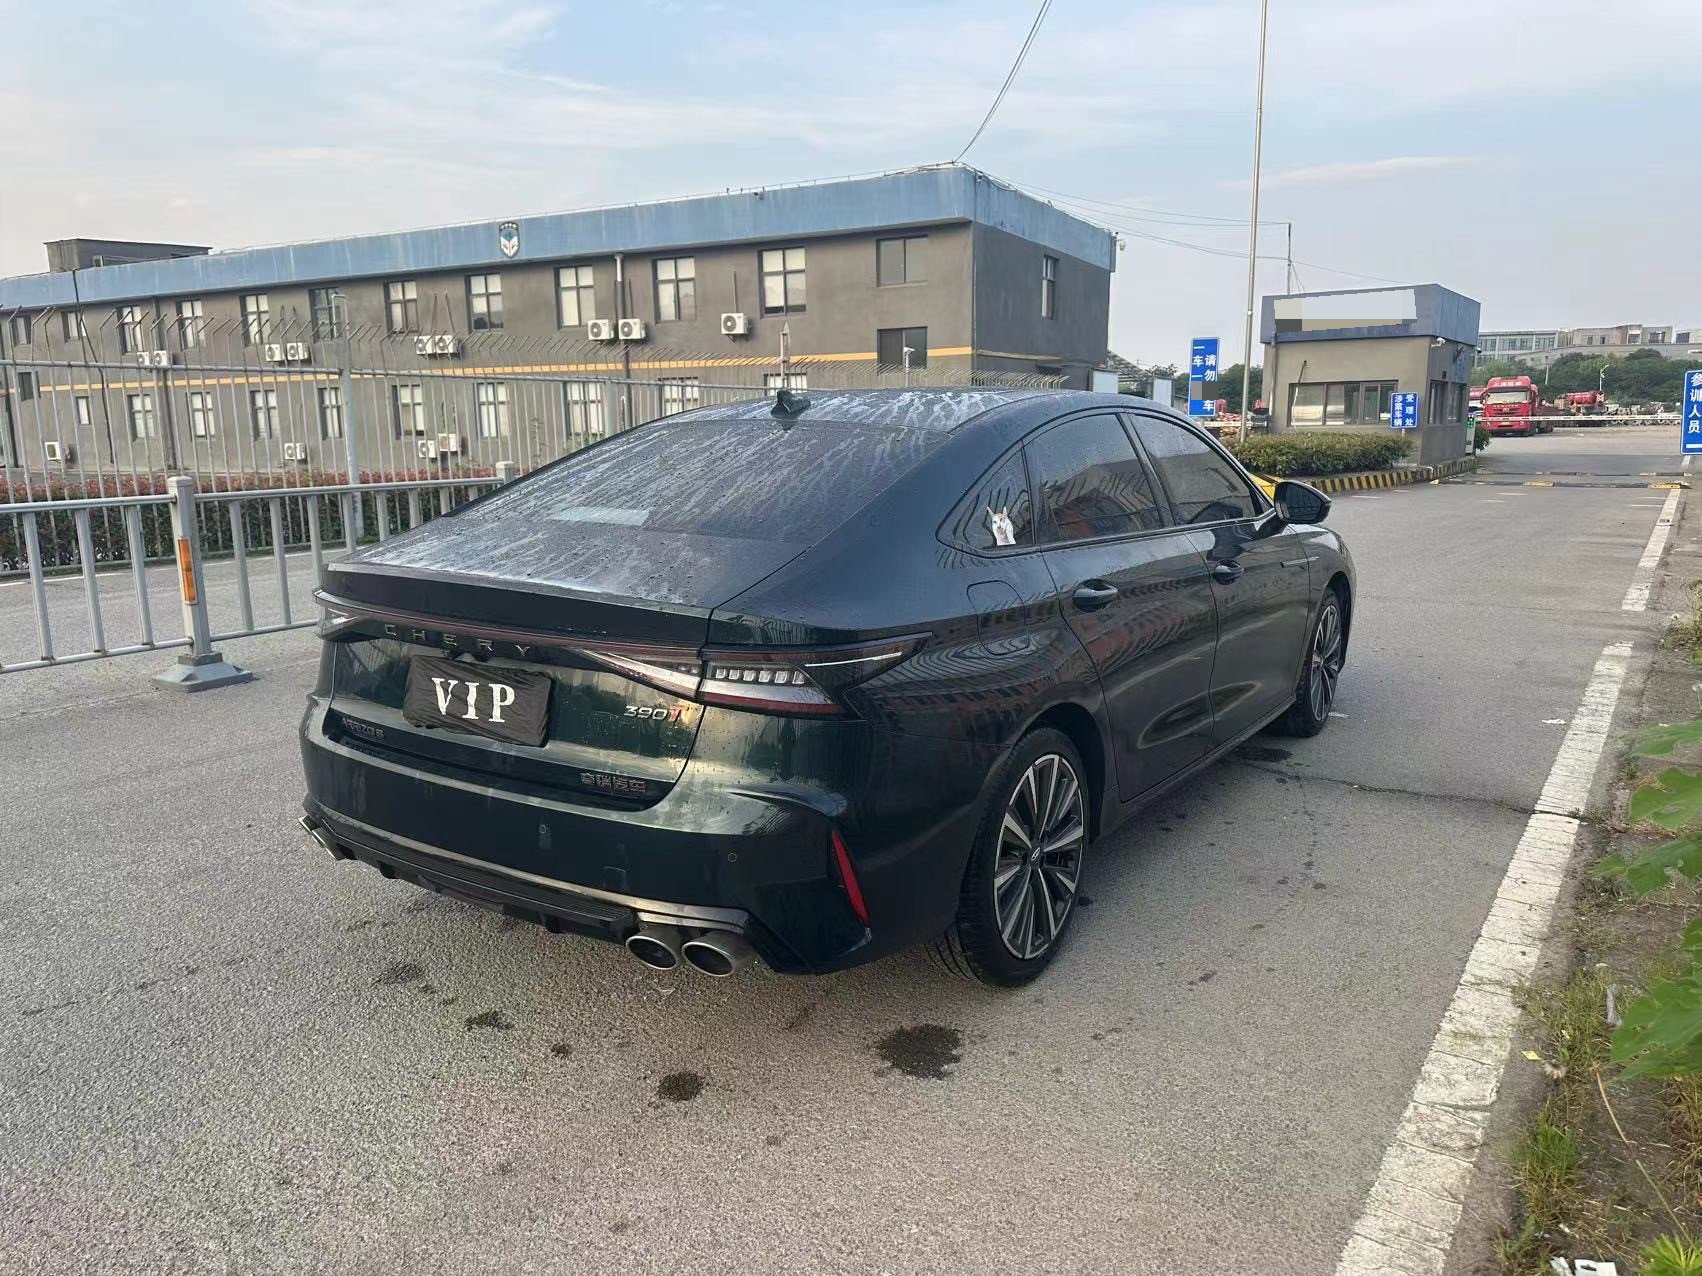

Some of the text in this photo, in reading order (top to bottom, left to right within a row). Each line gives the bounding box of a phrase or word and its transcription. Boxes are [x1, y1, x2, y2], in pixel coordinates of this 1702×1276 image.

[1203, 354, 1217, 411] 请勿车
[384, 623, 531, 657] CHERY
[431, 677, 515, 723] VIP
[623, 705, 690, 722] 390T
